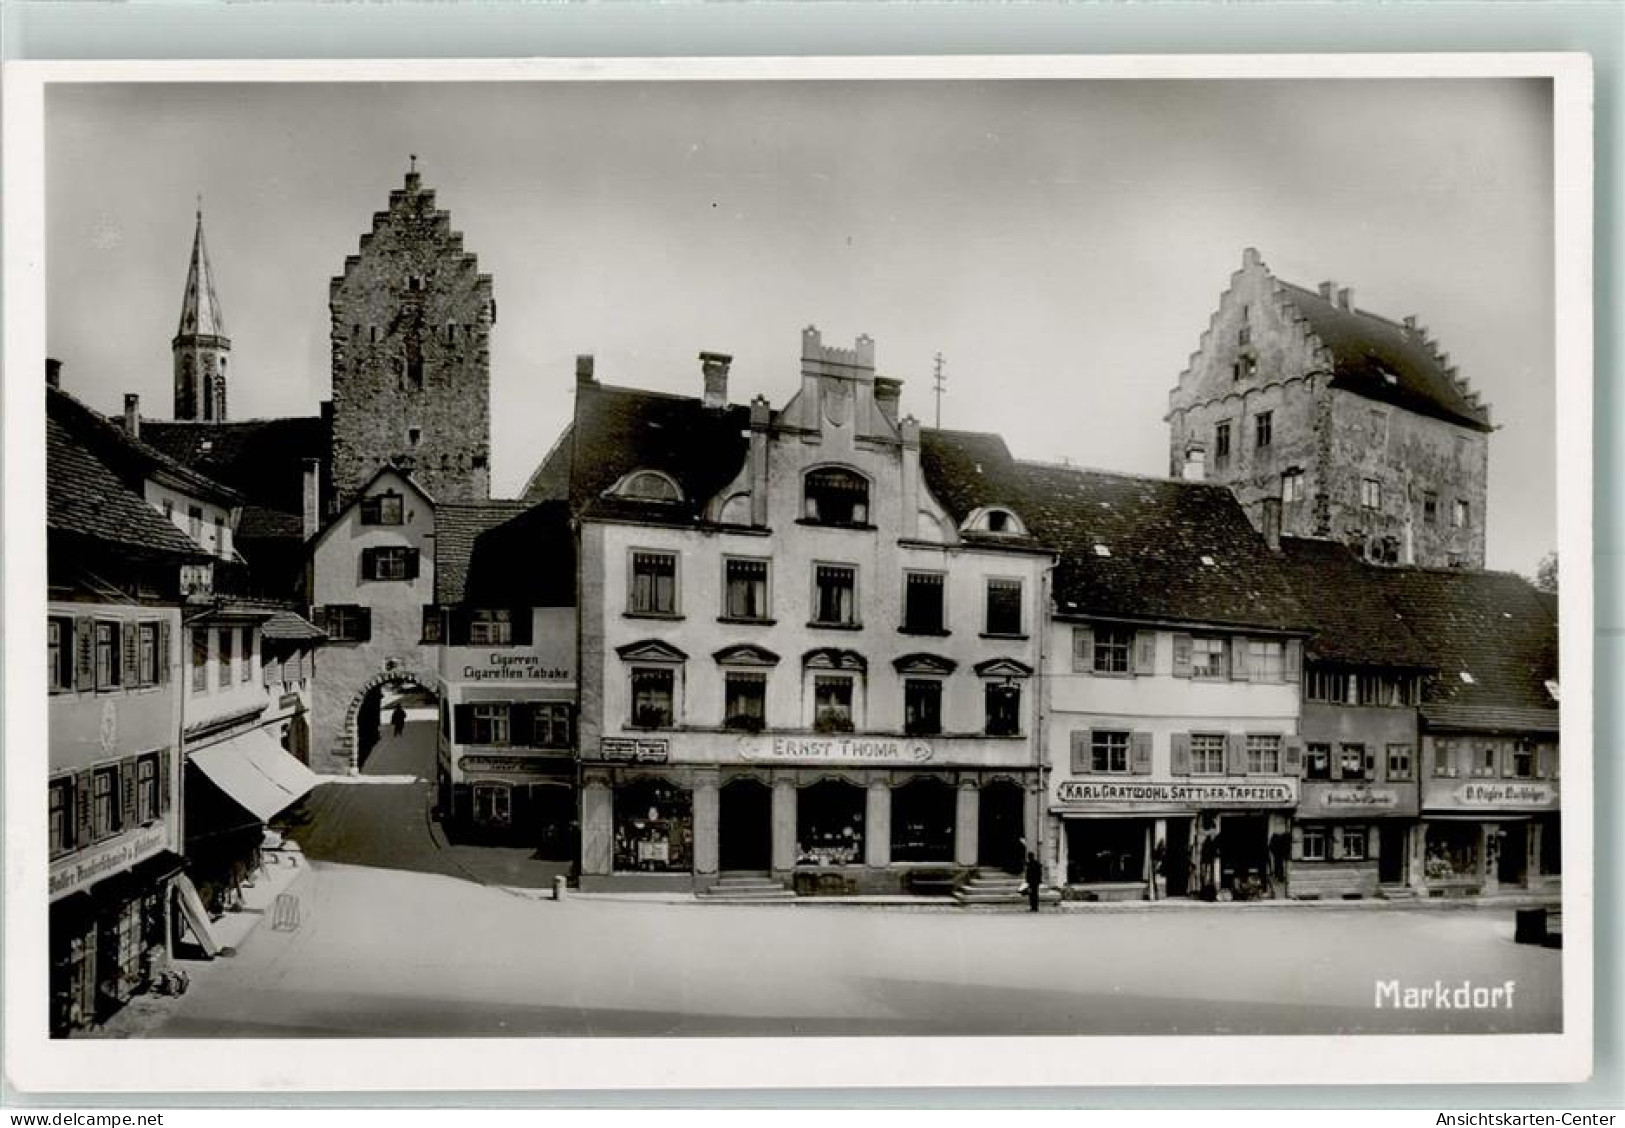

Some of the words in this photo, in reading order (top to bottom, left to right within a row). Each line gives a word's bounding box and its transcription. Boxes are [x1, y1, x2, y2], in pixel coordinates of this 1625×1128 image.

[490, 653, 539, 666] Cigarren
[464, 665, 523, 680] Cigaretten
[527, 666, 569, 679] Tabake
[773, 737, 832, 755] ERNST
[839, 739, 899, 757] THOMA
[1066, 785, 1100, 798] KARL
